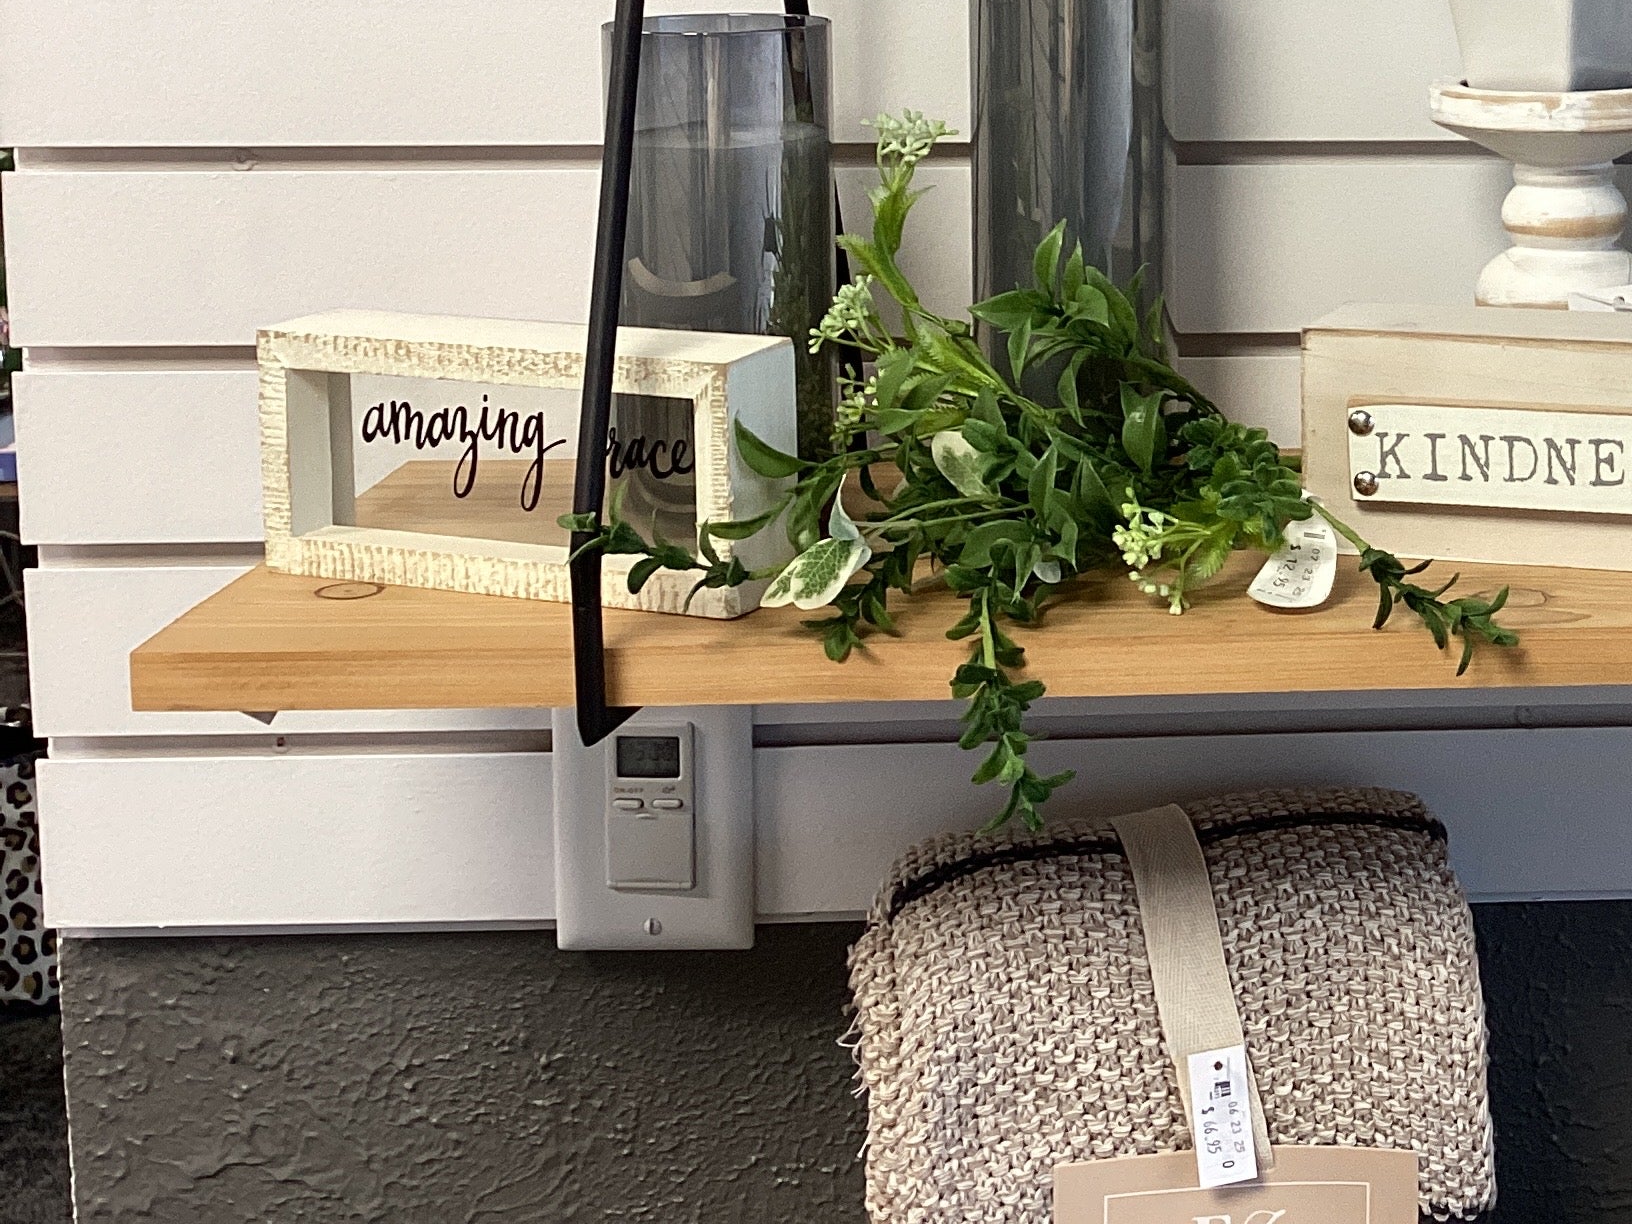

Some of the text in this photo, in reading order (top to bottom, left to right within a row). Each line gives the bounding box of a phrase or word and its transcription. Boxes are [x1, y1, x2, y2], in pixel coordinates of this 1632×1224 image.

[362, 394, 695, 511] amazing race
[1228, 1101, 1239, 1115] 06
[1203, 1121, 1222, 1154] 66.95
[1231, 1120, 1242, 1134] 23
